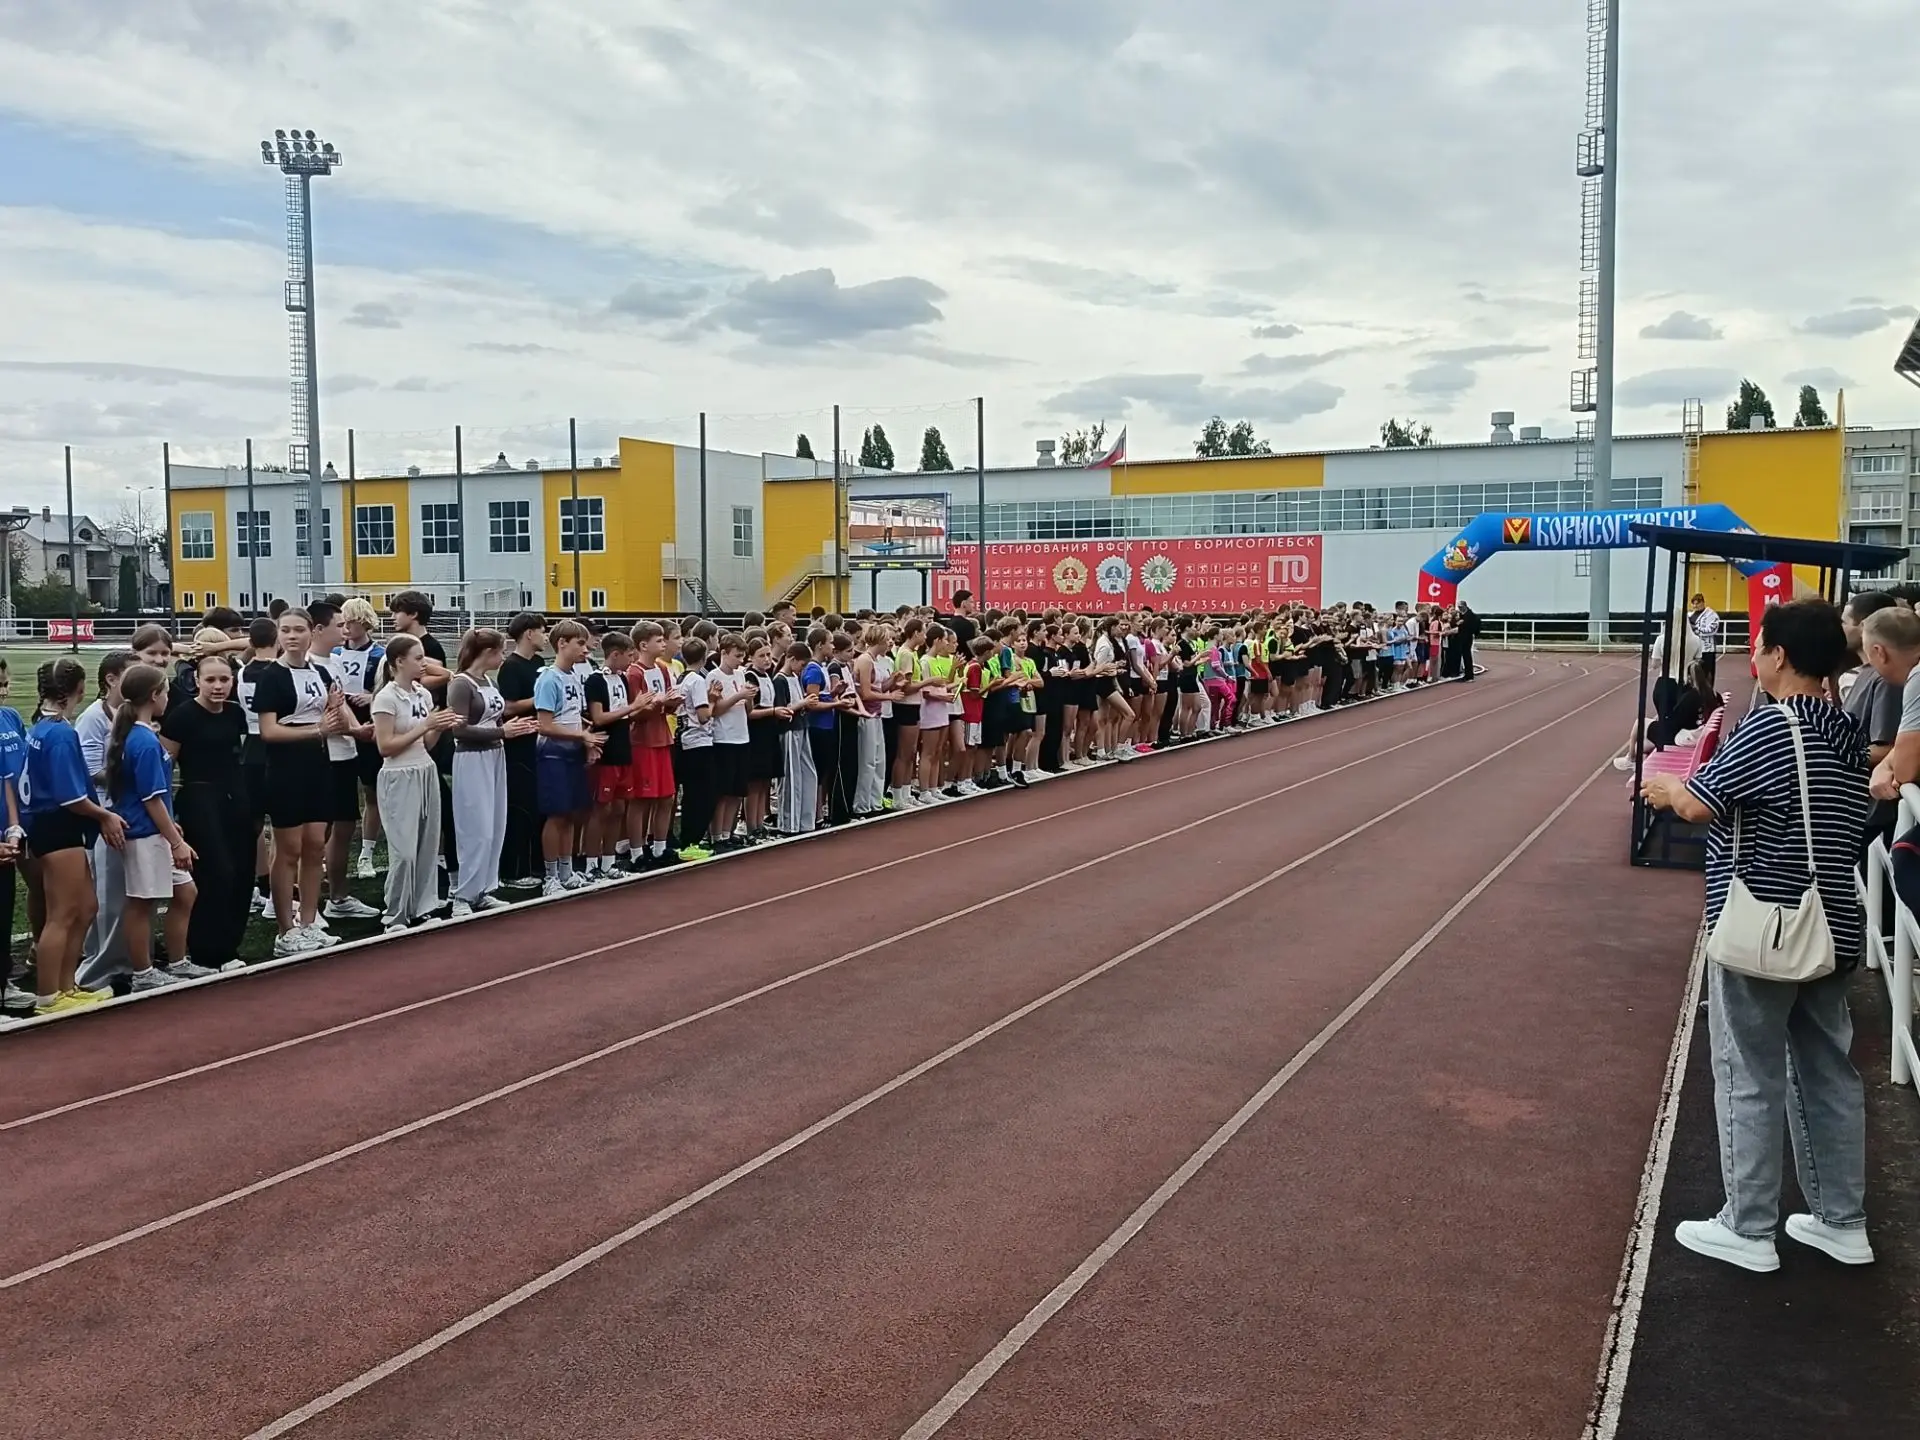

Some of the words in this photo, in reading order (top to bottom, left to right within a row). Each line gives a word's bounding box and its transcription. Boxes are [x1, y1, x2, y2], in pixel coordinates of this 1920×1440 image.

[947, 545, 977, 556] ЕНТР
[984, 542, 1089, 555] ТЕСТИРОВАНИЯ
[1097, 541, 1134, 552] ВФСК
[1142, 541, 1168, 551] ГТО
[1194, 536, 1315, 550] БОРИСОГЛЕБСК
[1267, 554, 1310, 583] ГТО
[342, 661, 360, 676] 52
[305, 681, 322, 697] 41
[565, 685, 579, 700] 54
[612, 685, 625, 699] 47
[652, 680, 663, 693] 51
[411, 703, 428, 719] 46
[489, 696, 503, 712] 45
